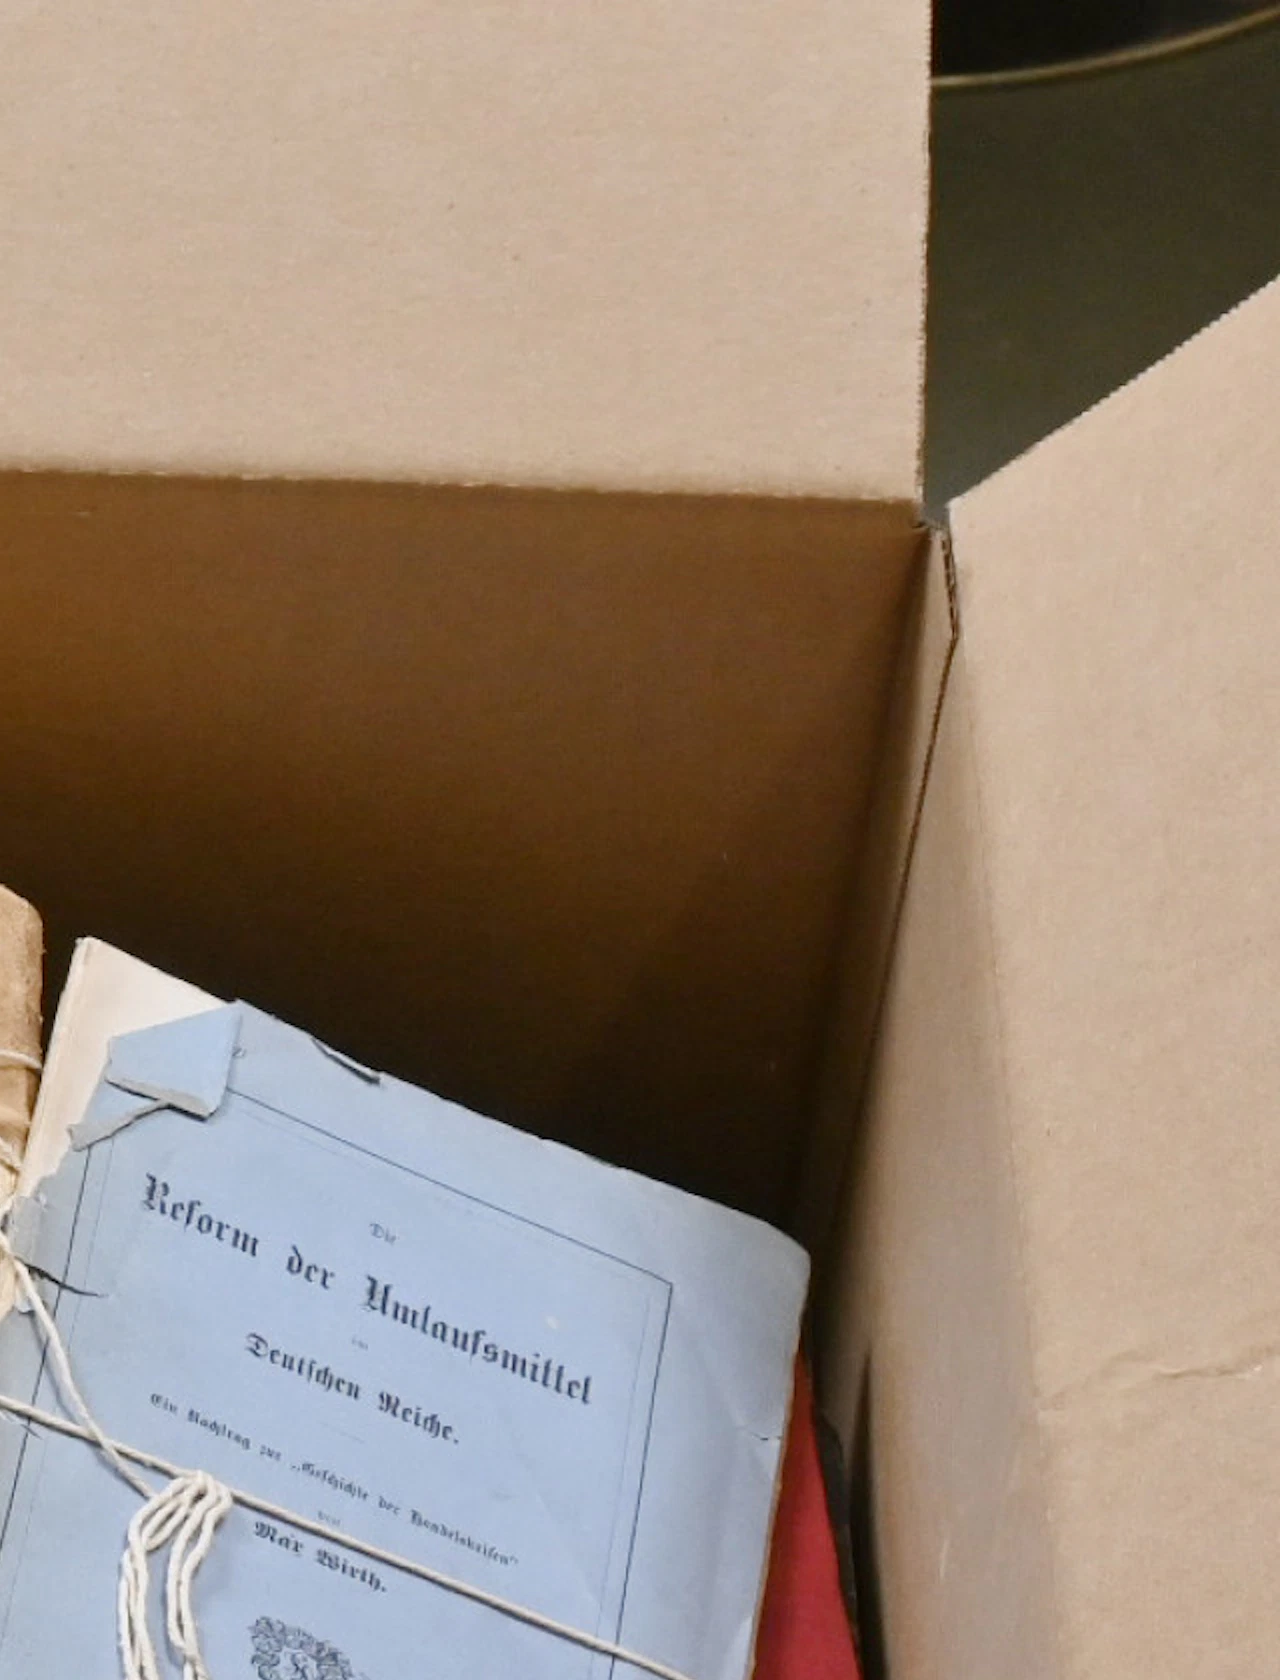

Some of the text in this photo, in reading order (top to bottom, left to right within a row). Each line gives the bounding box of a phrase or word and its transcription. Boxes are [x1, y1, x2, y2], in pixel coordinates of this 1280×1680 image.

[142, 1173, 260, 1258] Reform
[285, 1245, 336, 1290] der
[369, 1222, 398, 1246] Die
[378, 1390, 461, 1446] Reiche.
[149, 1392, 179, 1415] Ein
[186, 1408, 252, 1451] Nachtrag
[378, 1495, 401, 1516] der
[316, 1548, 389, 1595] Wirth.
